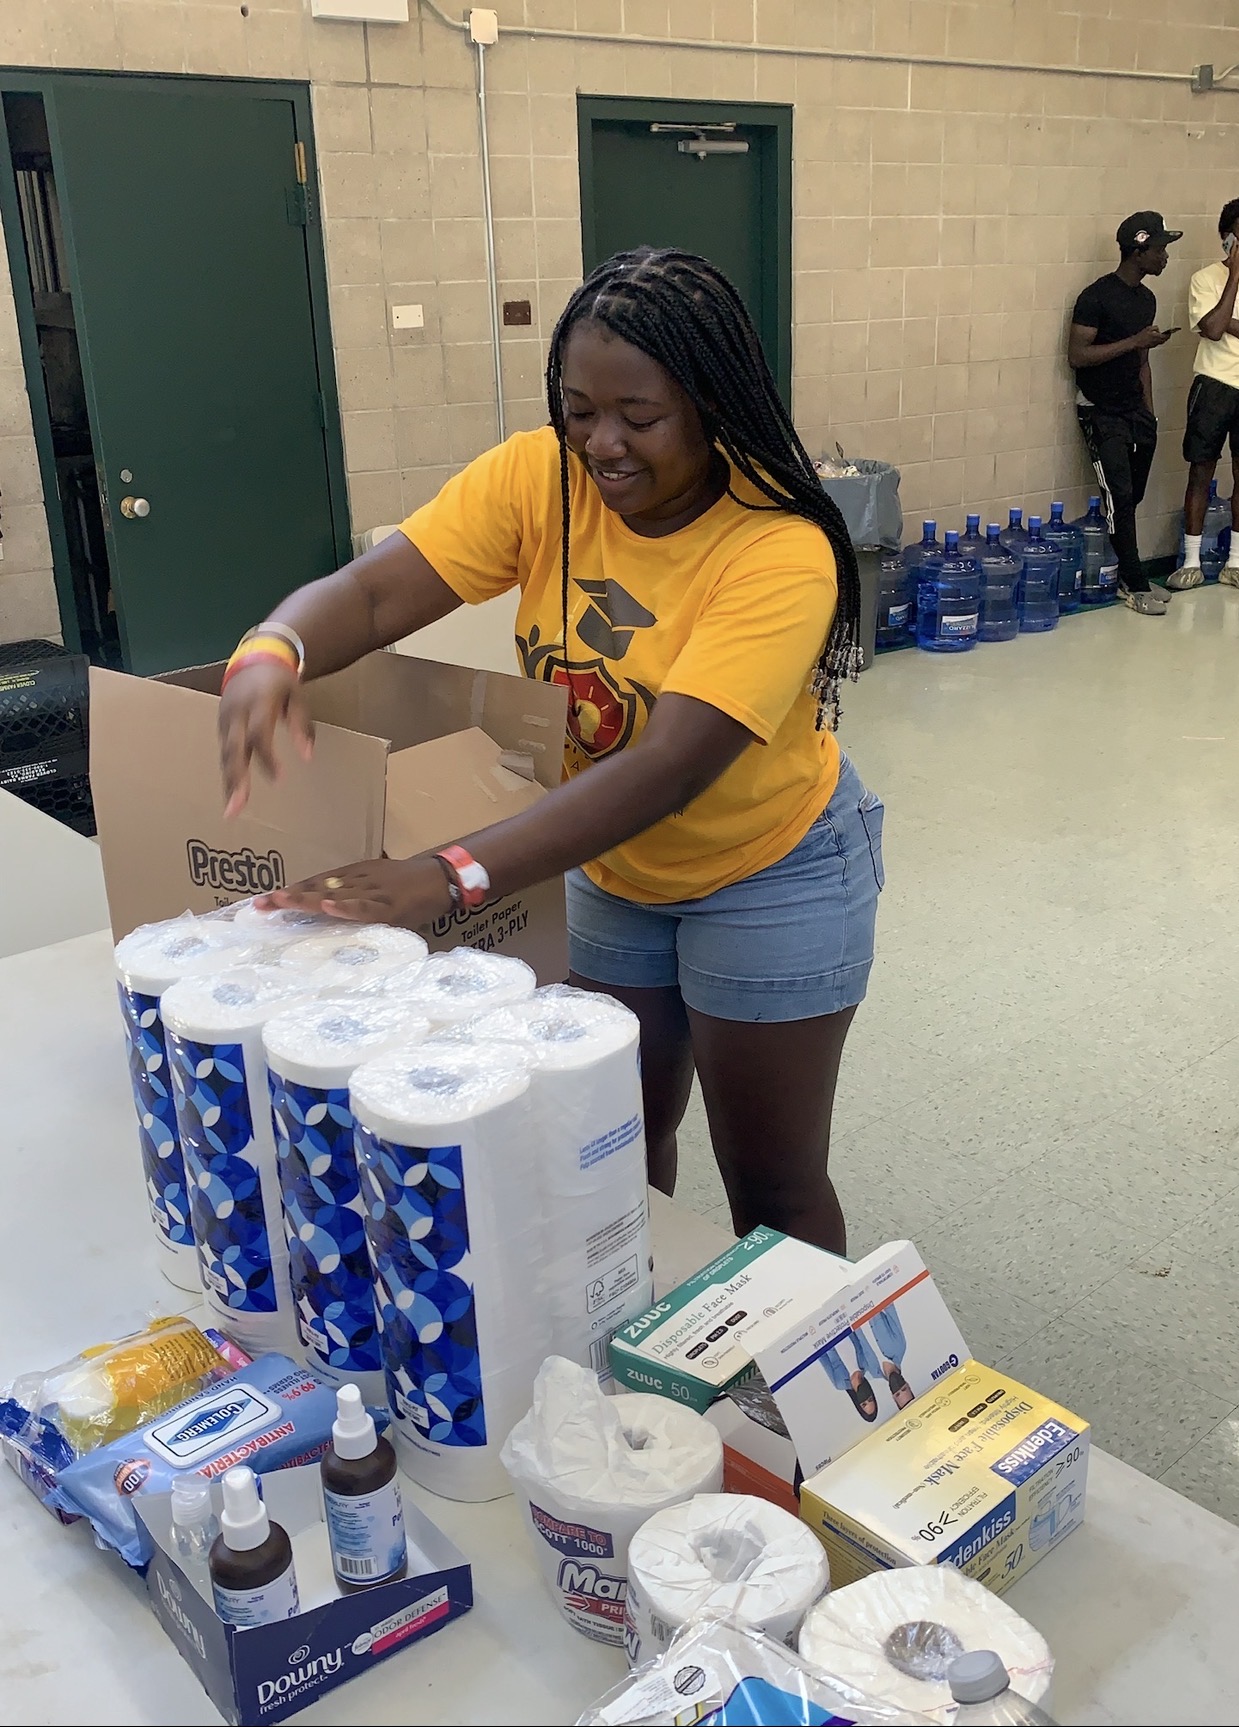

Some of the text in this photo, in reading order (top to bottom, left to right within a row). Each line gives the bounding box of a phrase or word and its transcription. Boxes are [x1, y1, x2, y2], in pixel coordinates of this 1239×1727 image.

[188, 841, 283, 892] Presto!
[461, 919, 489, 943] Toilet
[491, 900, 522, 924] Paper
[497, 909, 529, 944] 3-PLY
[623, 1302, 672, 1340] ZUUC
[651, 1309, 706, 1355] Disposable
[702, 1293, 727, 1313] Face
[724, 1273, 752, 1296] Mask
[850, 1300, 875, 1321] Disposable
[663, 1345, 680, 1360] Highly
[703, 1317, 713, 1326] and
[711, 1301, 735, 1320] breathable
[813, 1335, 828, 1350] Mask
[826, 1317, 850, 1340] Protective
[219, 1376, 239, 1391] HAND
[273, 1376, 301, 1396] ILLNESS
[281, 1382, 317, 1402] 99.9%
[626, 1368, 663, 1390] ZUUC
[671, 1382, 690, 1401] 50
[999, 1395, 1019, 1411] Highly
[176, 1402, 245, 1443] COLEMERG
[978, 1401, 1034, 1444] Disposable
[815, 1456, 832, 1471] Pieces
[954, 1440, 984, 1462] Face
[997, 1421, 1066, 1474] Edenkiss
[123, 1469, 145, 1493] 100
[926, 1459, 960, 1488] Mask
[950, 1486, 980, 1511] EFFICIENCY
[957, 1492, 988, 1518] FILTRATION
[532, 1507, 607, 1546] COMPARE TO
[823, 1510, 840, 1527] Three
[839, 1520, 858, 1540] layers
[858, 1535, 867, 1544] of
[865, 1540, 897, 1566] protection
[978, 1546, 995, 1566] Face
[994, 1528, 1015, 1549] Mask
[1001, 1543, 1023, 1579] 50
[374, 1593, 446, 1639] ODOR DEFENSE
[601, 1603, 627, 1616] PRI
[257, 1648, 344, 1705] Downy
[259, 1675, 328, 1715] fresh protect
